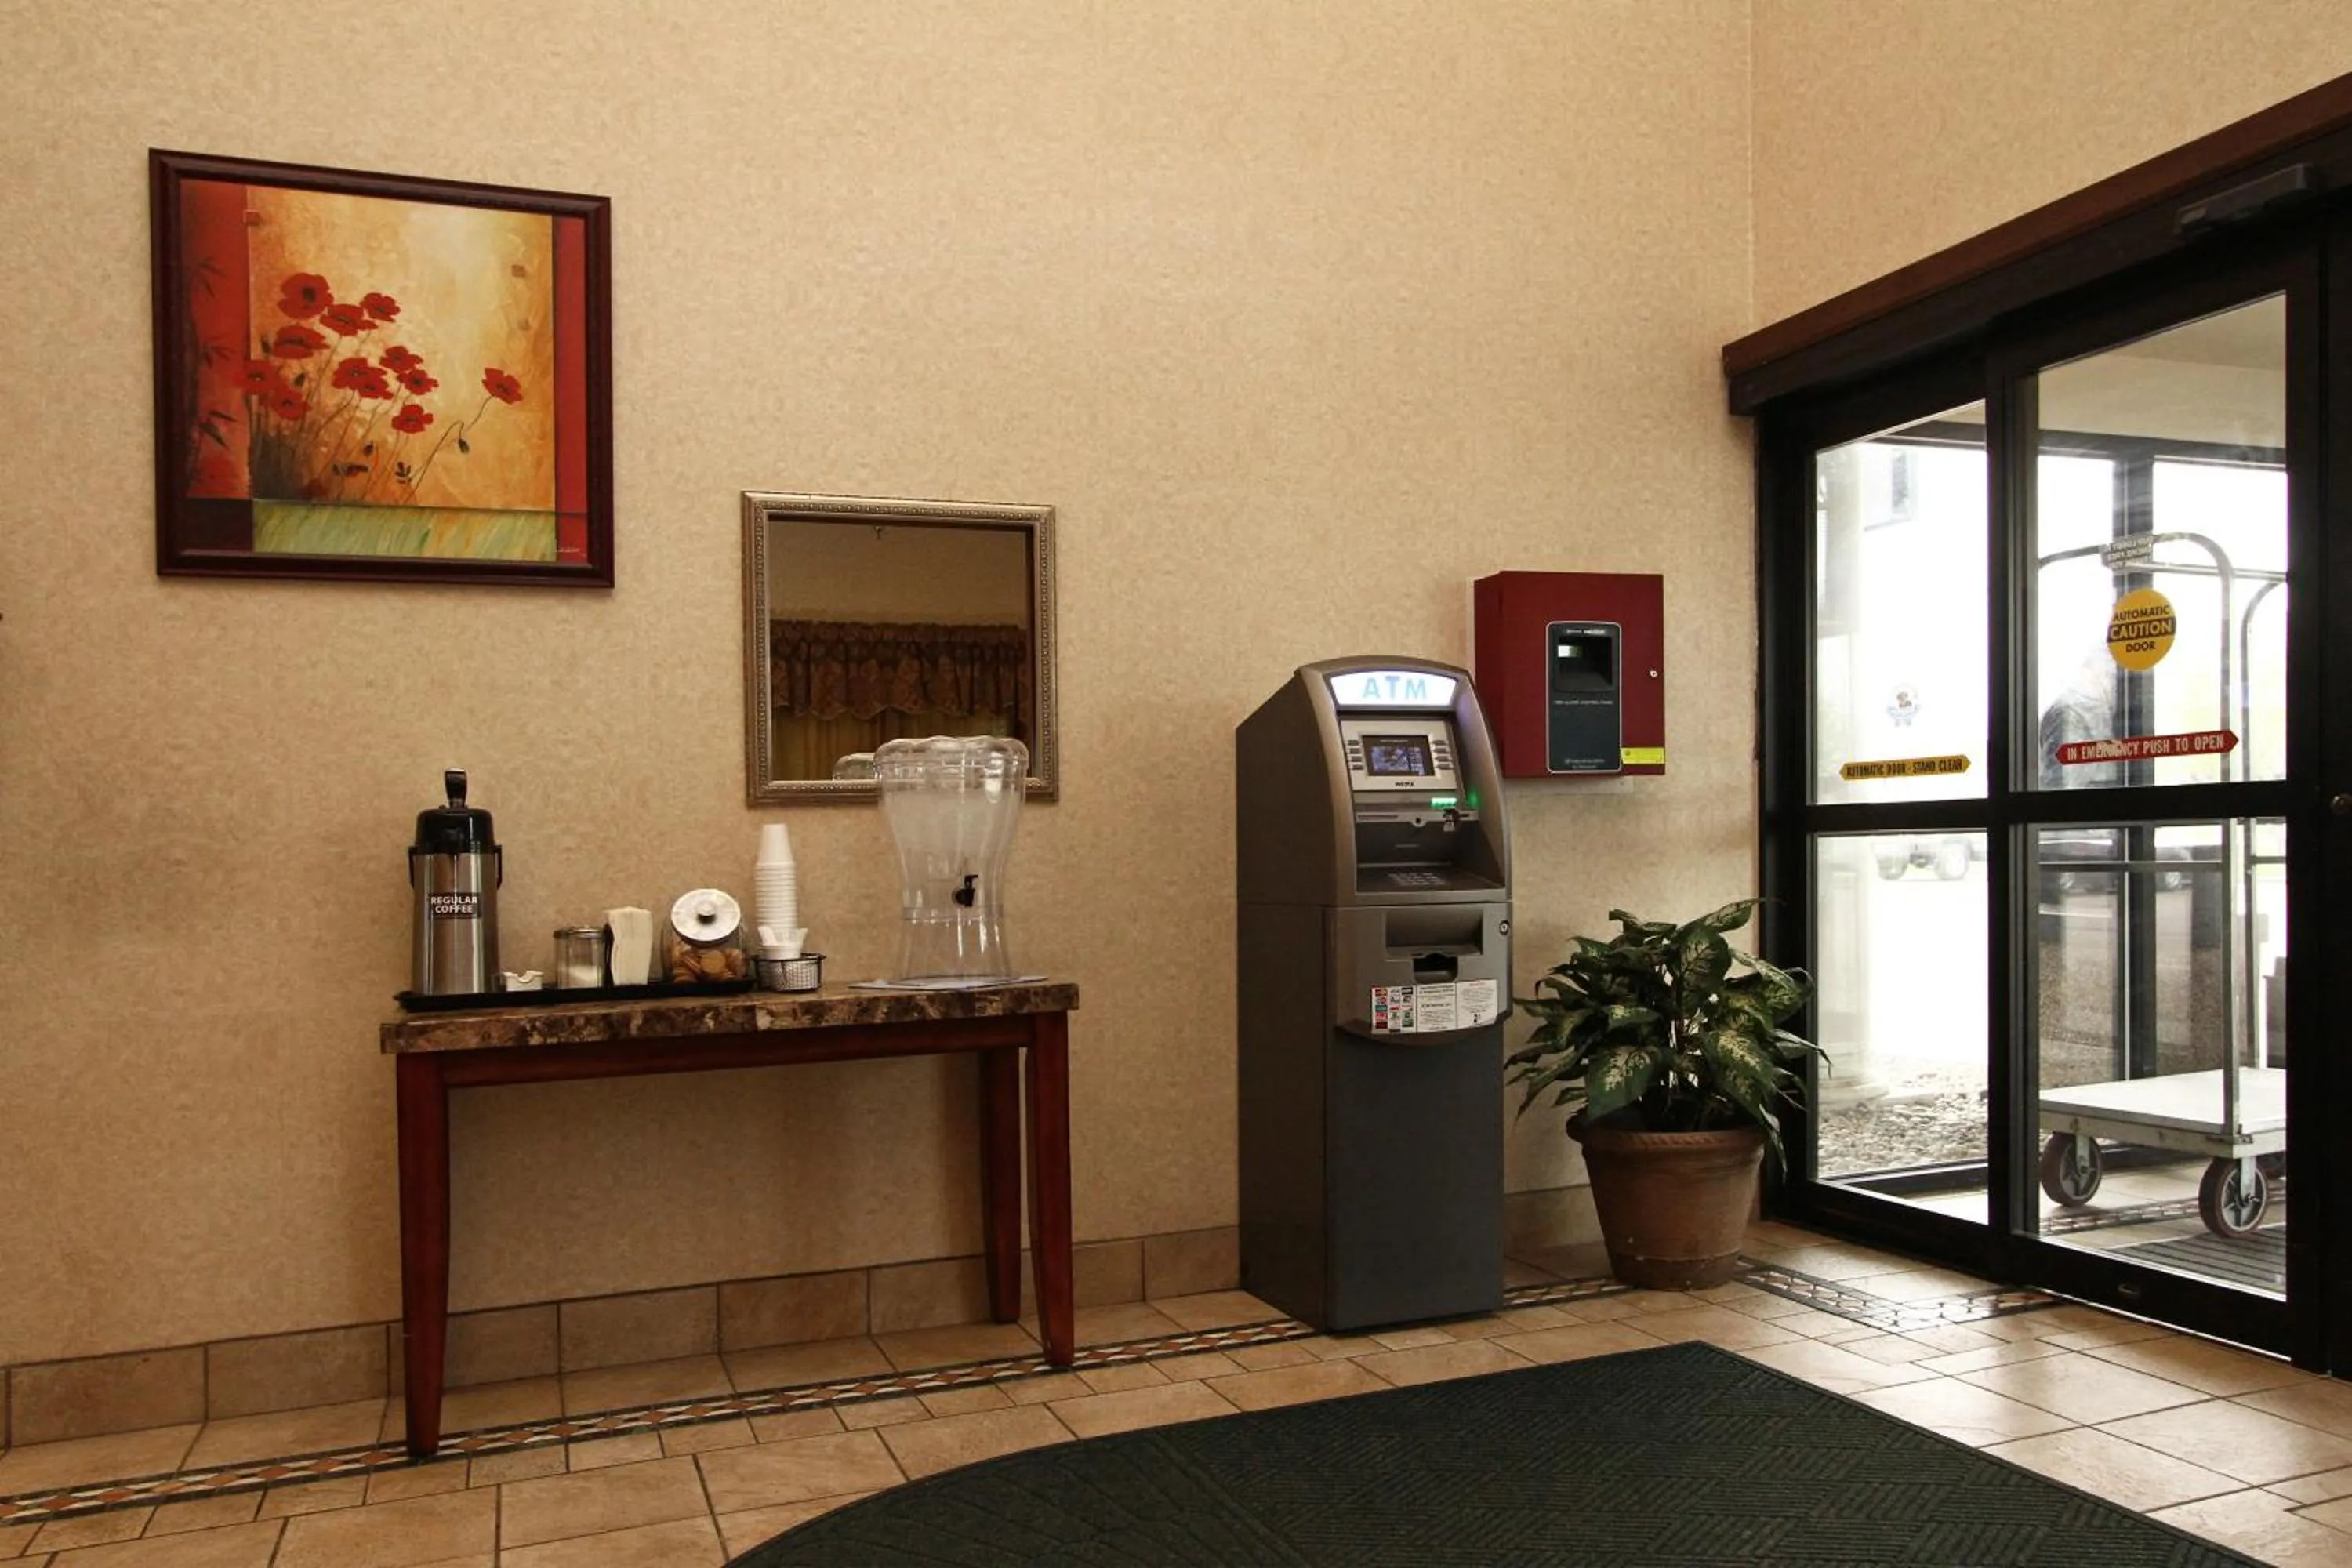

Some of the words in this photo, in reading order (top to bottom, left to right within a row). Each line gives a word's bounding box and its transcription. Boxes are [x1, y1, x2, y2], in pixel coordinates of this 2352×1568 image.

[2113, 604, 2171, 621] AUTOMATIC
[2110, 619, 2172, 640] CAUTION
[2125, 641, 2156, 653] DOOR
[1362, 675, 1427, 700] ATM
[2067, 746, 2078, 761] IN
[2143, 739, 2170, 755] PUSH
[2175, 737, 2189, 752] TO
[2194, 734, 2224, 750] OPEN
[1846, 764, 1884, 777] AUTOMATIC
[1886, 763, 1906, 775] DOOR
[1912, 760, 1936, 774] STAND
[1939, 758, 1963, 772] CLEAR
[434, 904, 474, 913] COFFEE
